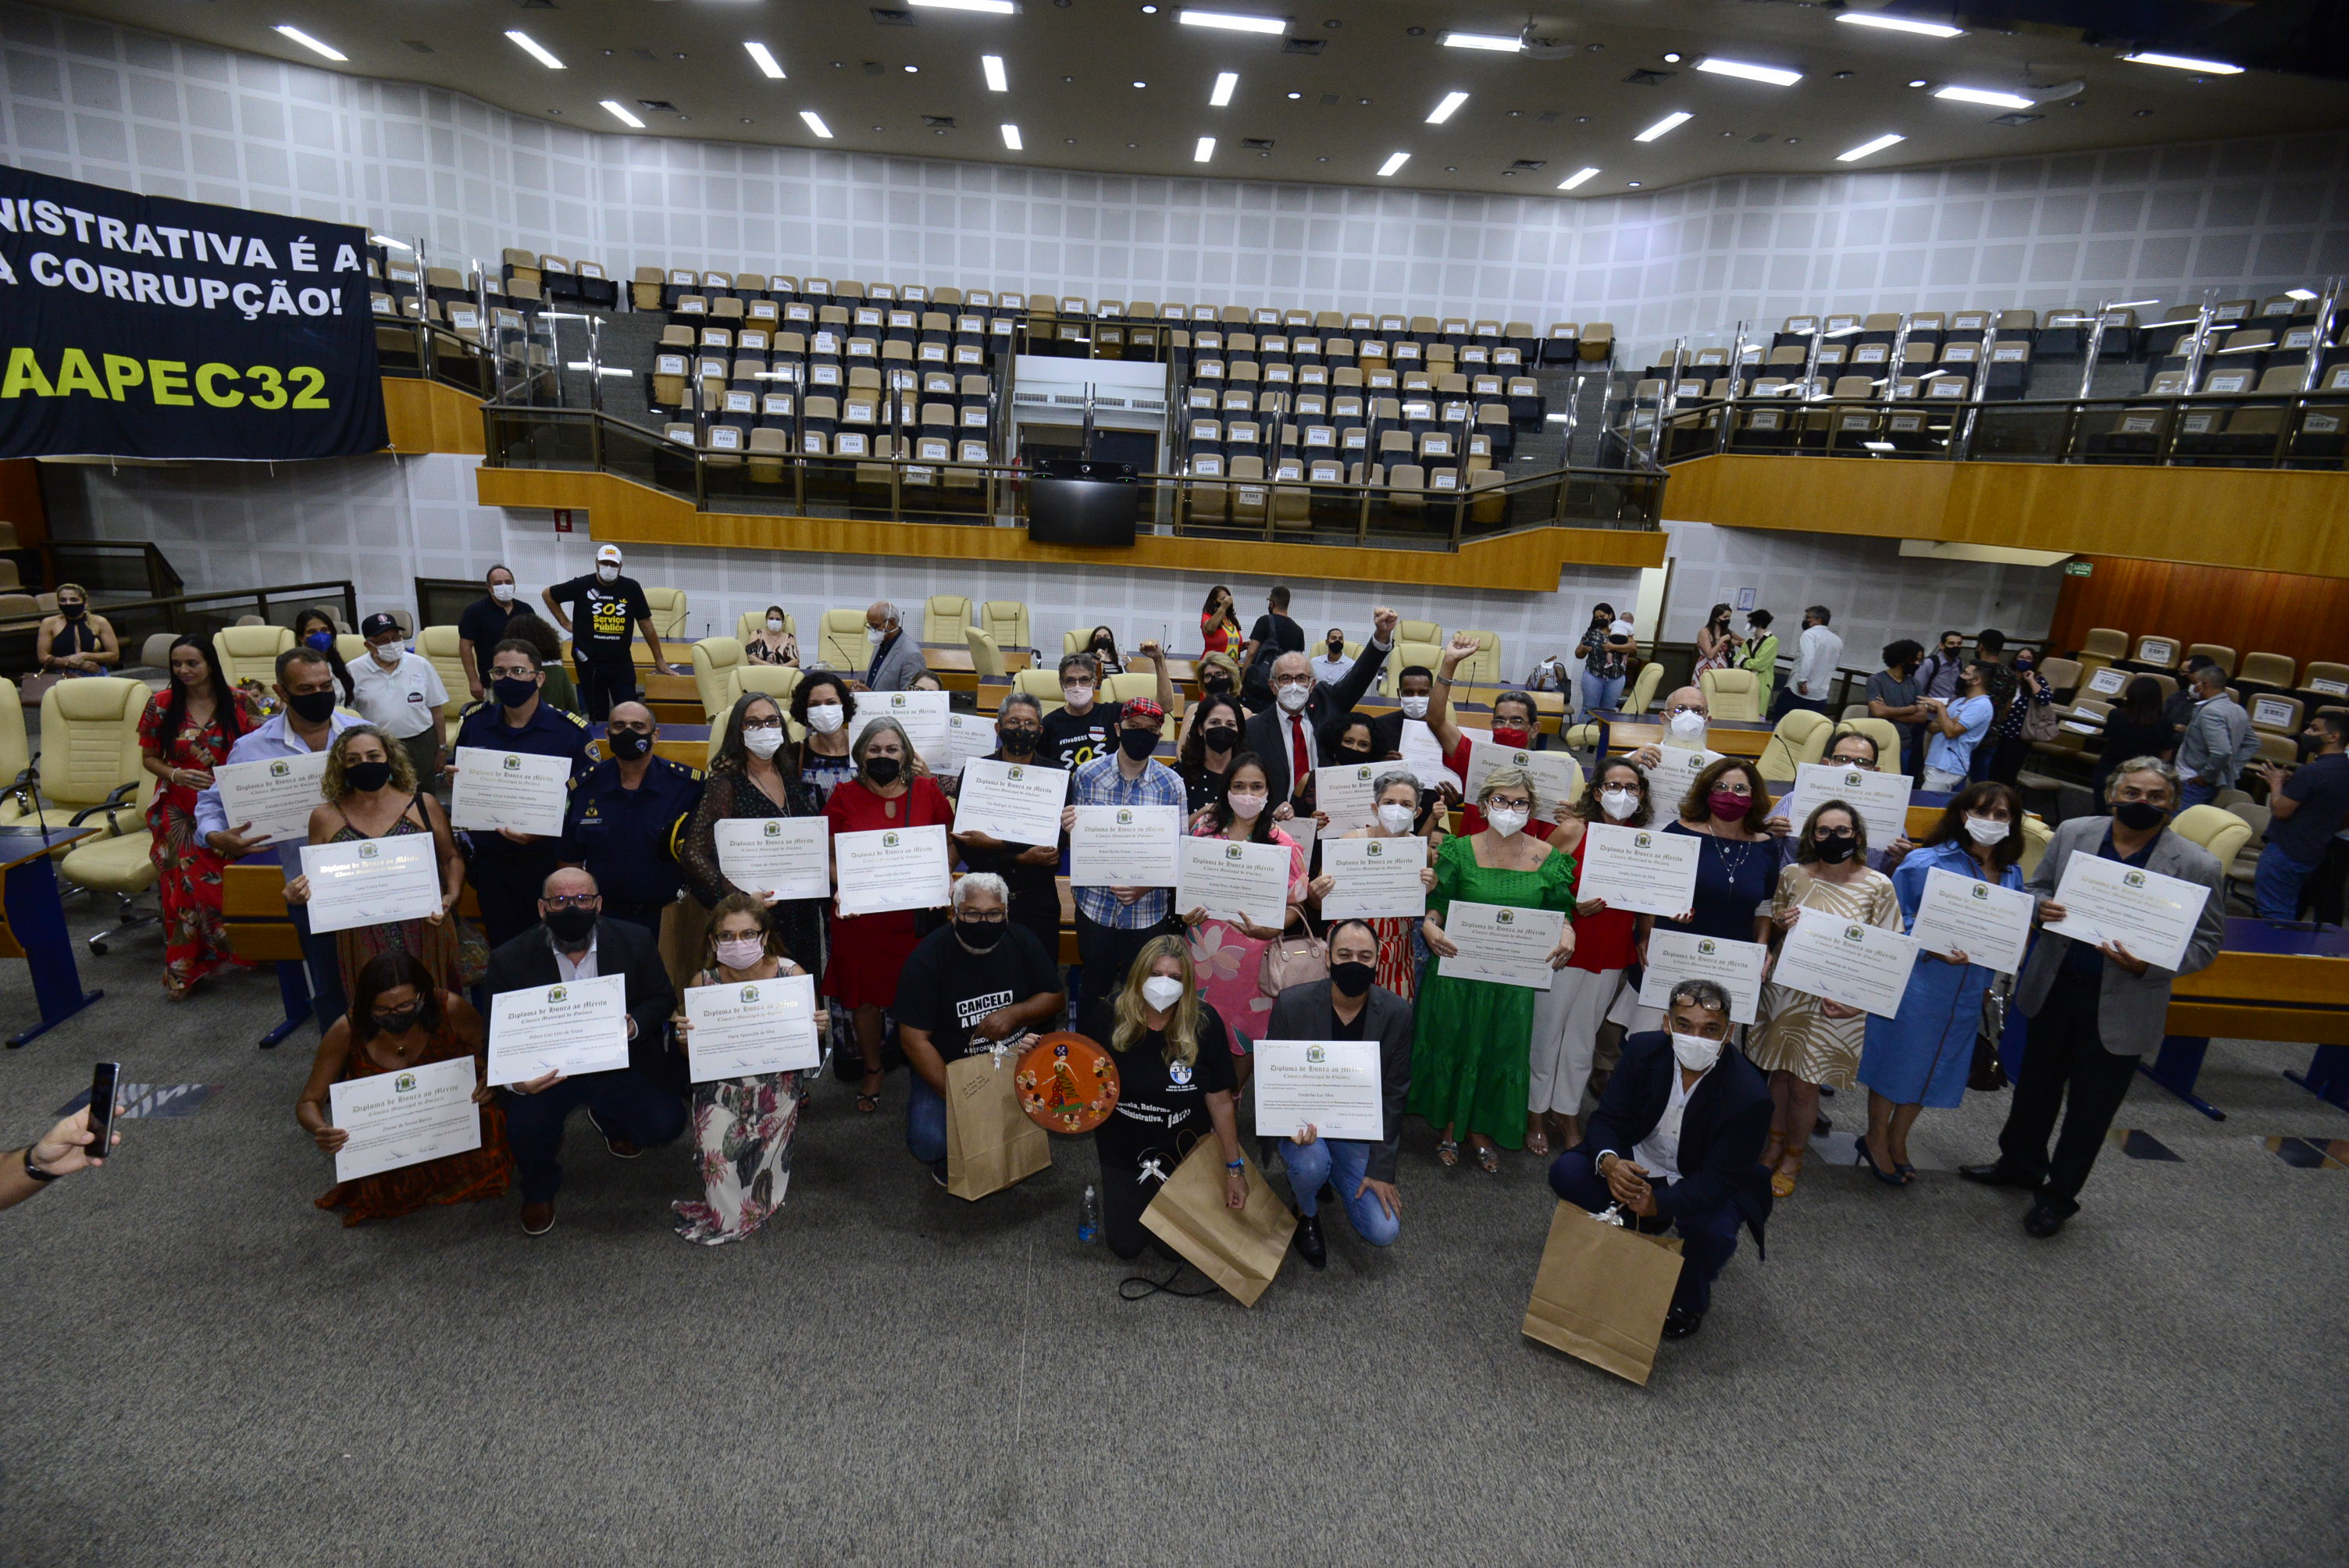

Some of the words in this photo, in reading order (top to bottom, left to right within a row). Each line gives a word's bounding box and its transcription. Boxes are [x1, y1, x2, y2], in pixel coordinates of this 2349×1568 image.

[291, 236, 319, 272] É
[333, 244, 361, 273] A
[30, 252, 342, 320] CORRUPÇÃO!
[1, 347, 330, 410] AAPEC32
[591, 602, 626, 616] SOS
[593, 615, 626, 625] Serviço
[594, 622, 625, 632] Público
[1060, 743, 1107, 770] SOS
[1599, 844, 1624, 853] Diploma
[1461, 921, 1486, 929] Diploma
[958, 992, 1011, 1015] CANCELA
[508, 1010, 536, 1019] Diploma
[961, 1017, 969, 1028] A
[352, 1102, 385, 1113] Diploma
